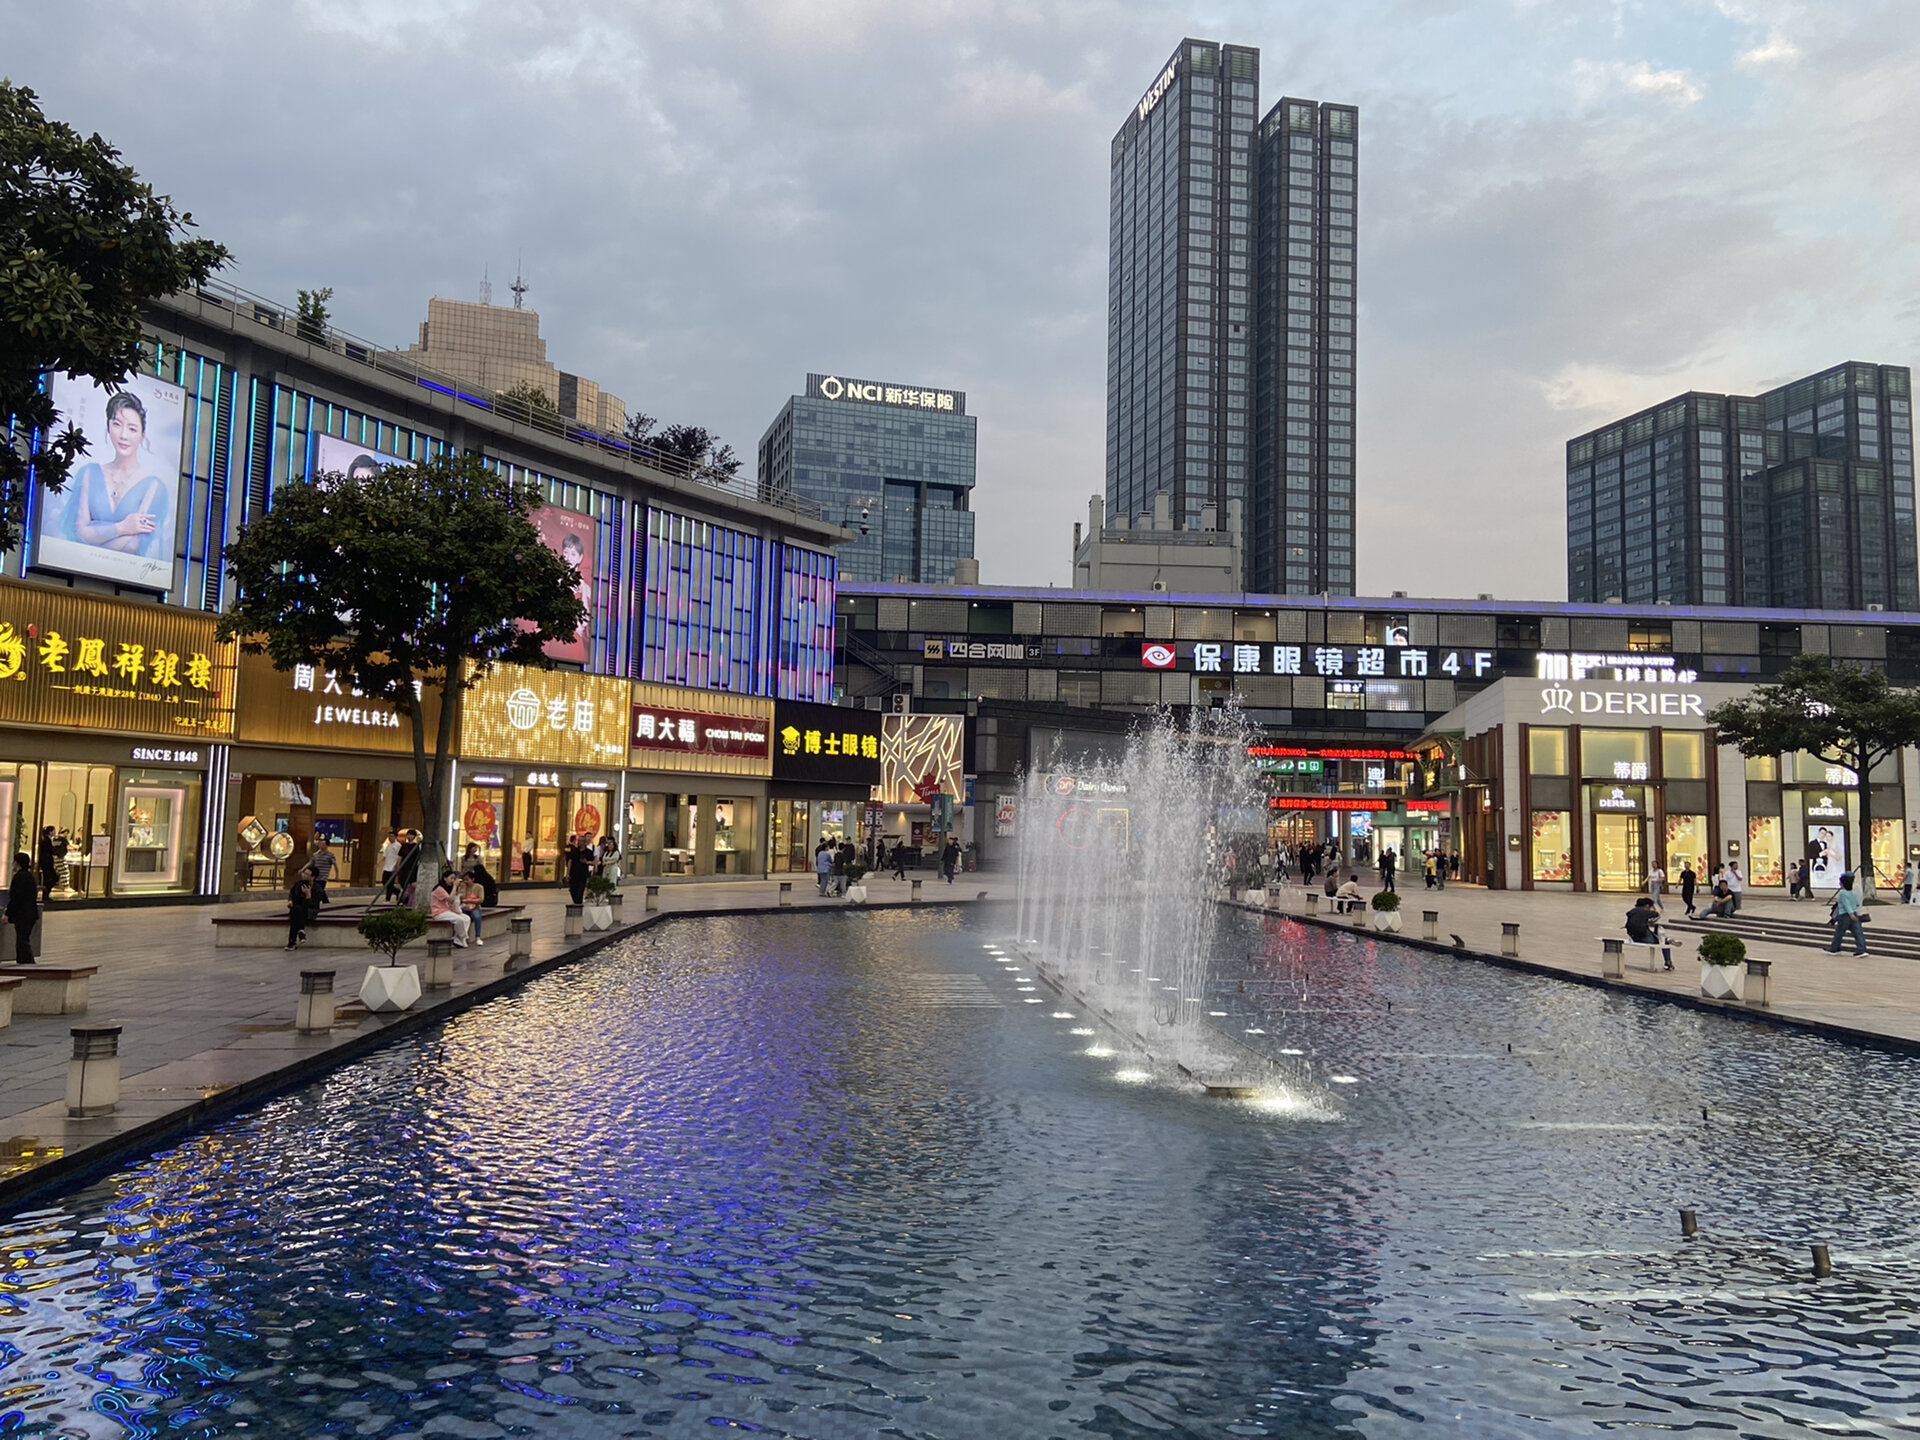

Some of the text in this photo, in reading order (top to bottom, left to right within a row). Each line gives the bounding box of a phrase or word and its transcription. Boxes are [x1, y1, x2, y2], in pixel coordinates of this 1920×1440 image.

[1138, 60, 1175, 121] WESTIN
[847, 382, 954, 410] NCI 新华保险
[950, 642, 1041, 660] 四合网咖 3F
[546, 695, 595, 732] 老庙
[1580, 691, 1705, 717] DERIER
[636, 713, 696, 743] 周大福
[132, 747, 199, 763] SINCE 1848
[804, 729, 878, 759] 博士眼镜
[1599, 799, 1636, 808] DERIER
